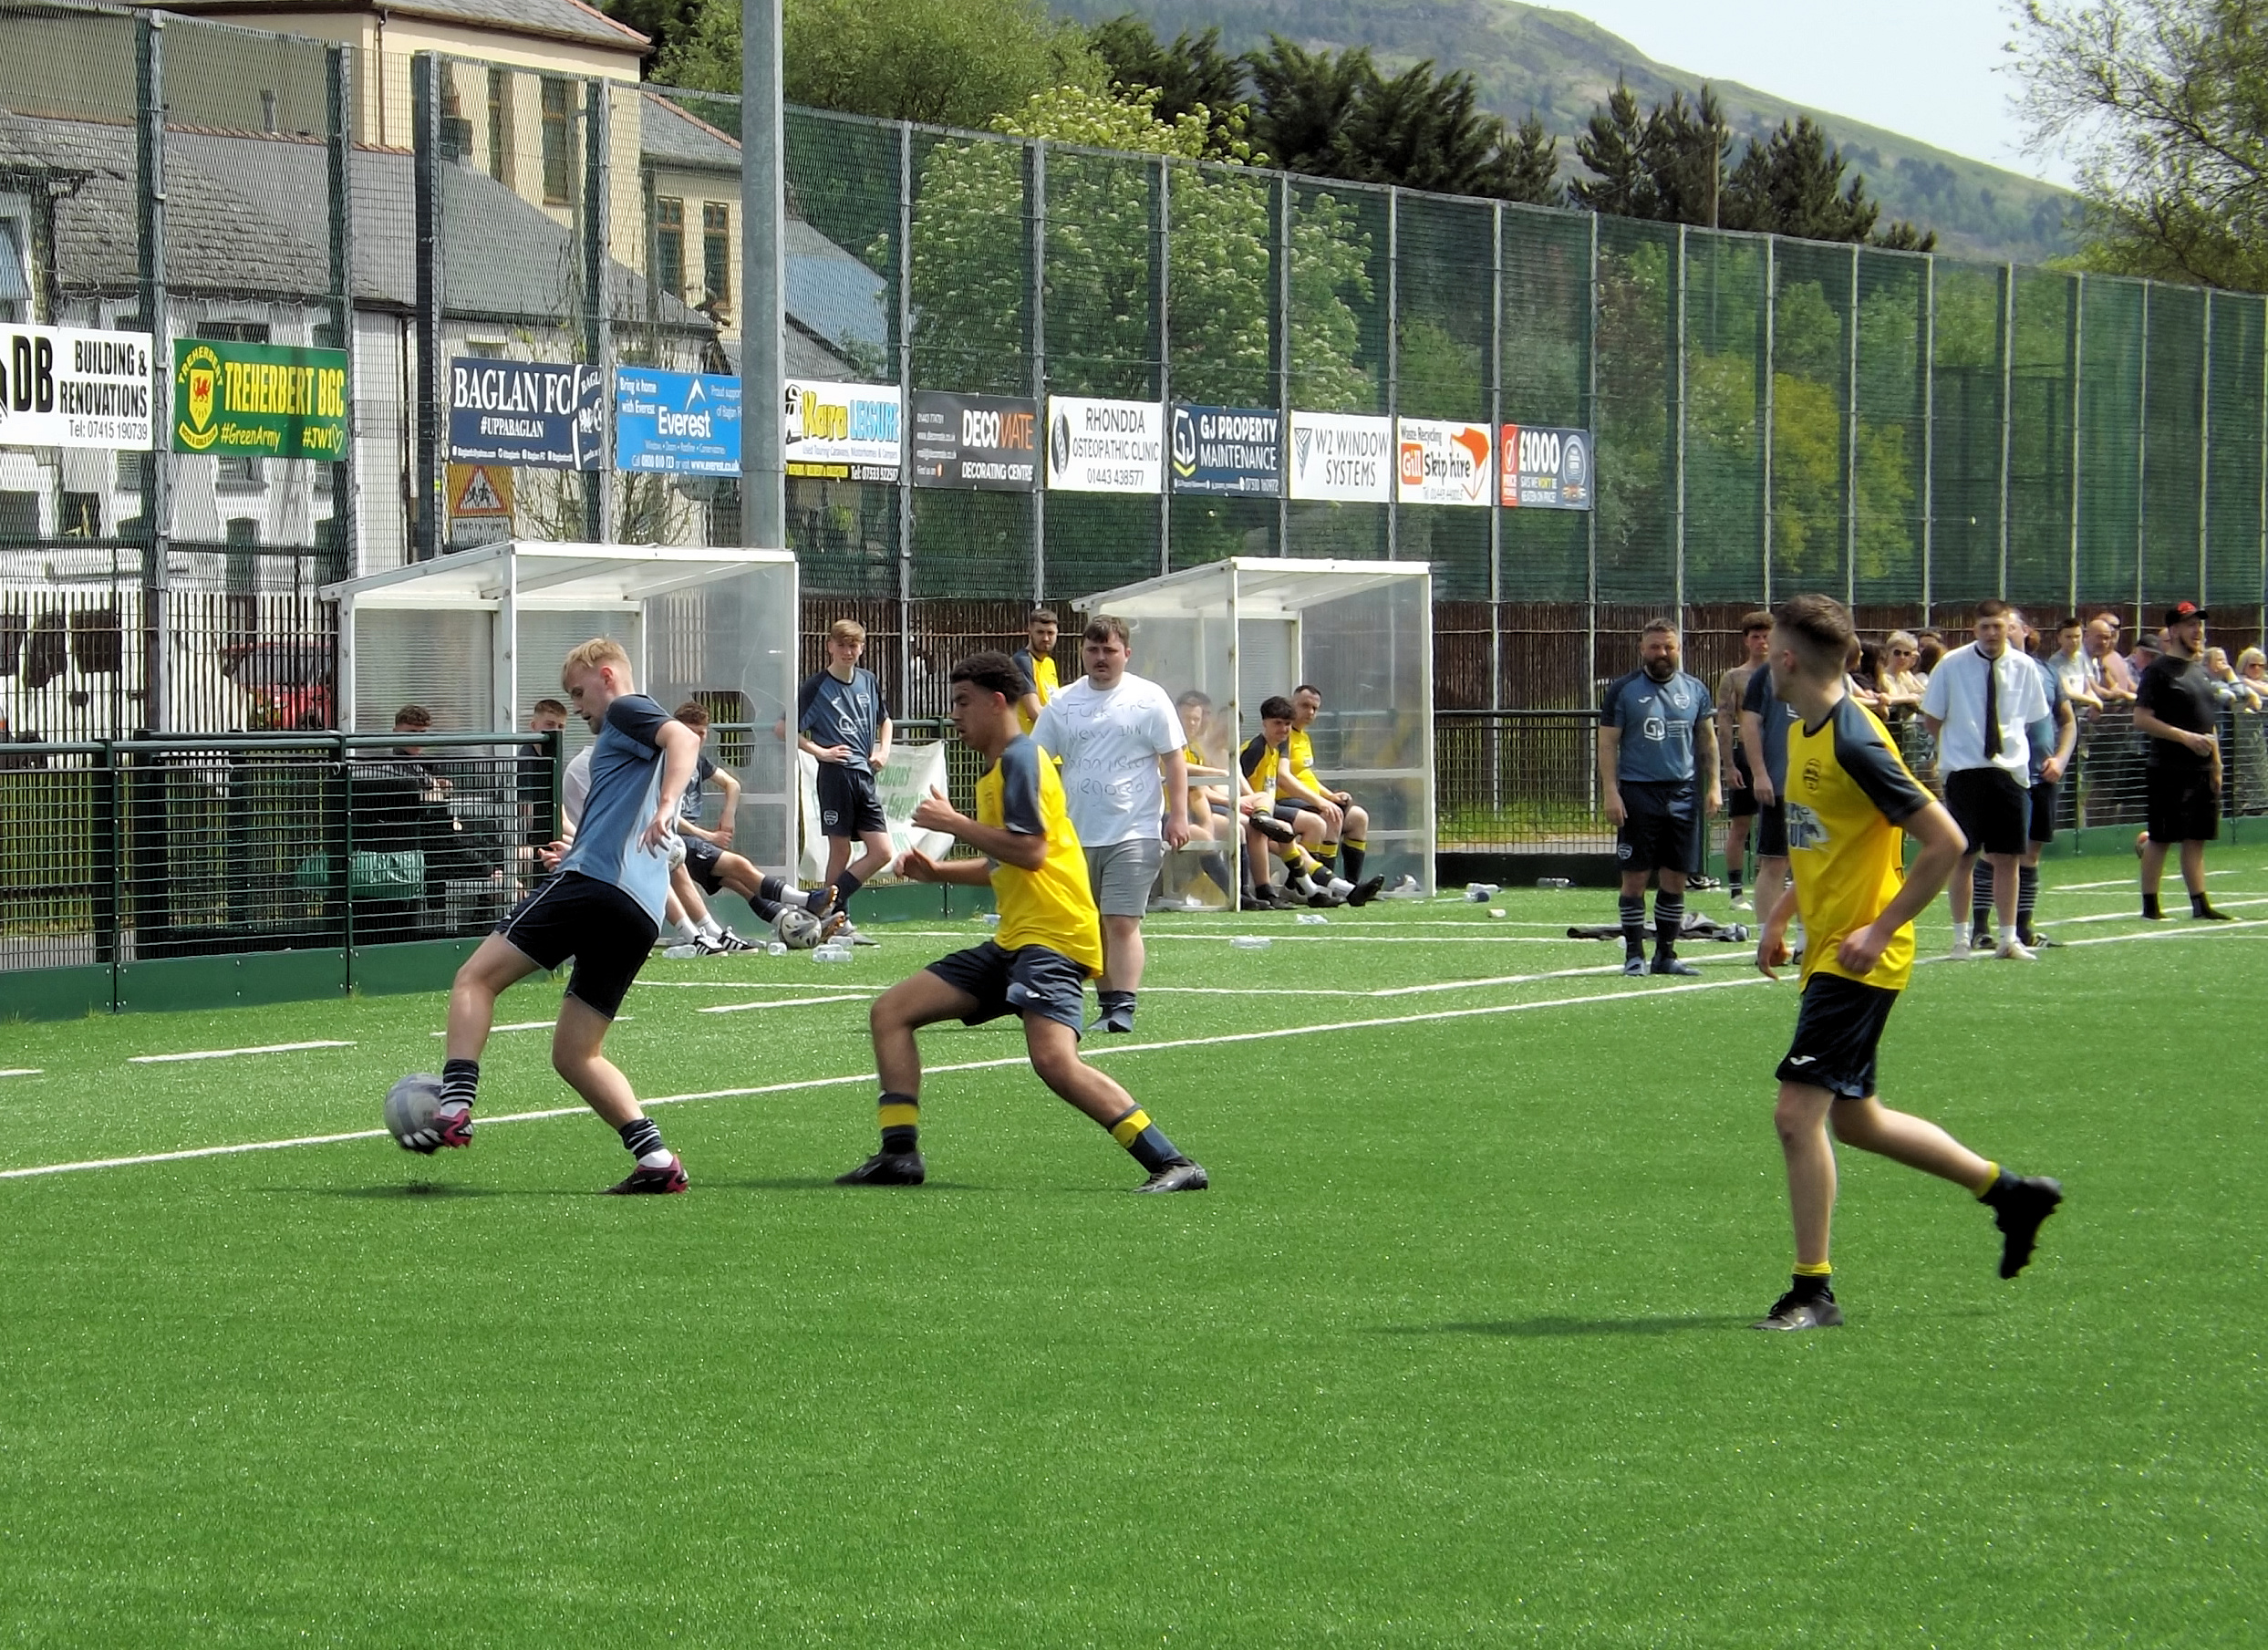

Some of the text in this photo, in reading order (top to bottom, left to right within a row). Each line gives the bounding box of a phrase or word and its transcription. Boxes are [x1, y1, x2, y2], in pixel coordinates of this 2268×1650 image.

[75, 339, 147, 377] BUILDING &
[13, 335, 53, 412] DB
[60, 380, 147, 418] RENOVATIONS
[224, 361, 345, 418] TREHERBERT BGC
[454, 368, 571, 415] BAGLAN FC
[636, 400, 656, 414] Everest
[850, 400, 899, 442] LEISURE
[1086, 407, 1145, 433] RHONDDA
[69, 420, 148, 440] Tel: 07415 190739
[481, 416, 544, 438] #UPPABAGLAN
[658, 406, 711, 438] Everest
[1200, 414, 1277, 443] GJ PROPERTY
[221, 422, 281, 453] #GreenArmy
[1072, 437, 1159, 462] OSTEOPATHIC CLINIC
[1315, 428, 1389, 457] W2 WINDOW
[1200, 443, 1277, 471] MAINTENANCE
[1519, 431, 1560, 474] £1000
[961, 462, 1006, 481] DECORATING
[1087, 468, 1144, 486] 01443 438577
[1326, 459, 1376, 487] SYSTEMS
[1424, 451, 1447, 486] Skip
[1449, 452, 1471, 478] hire
[1117, 724, 1141, 737] INN
